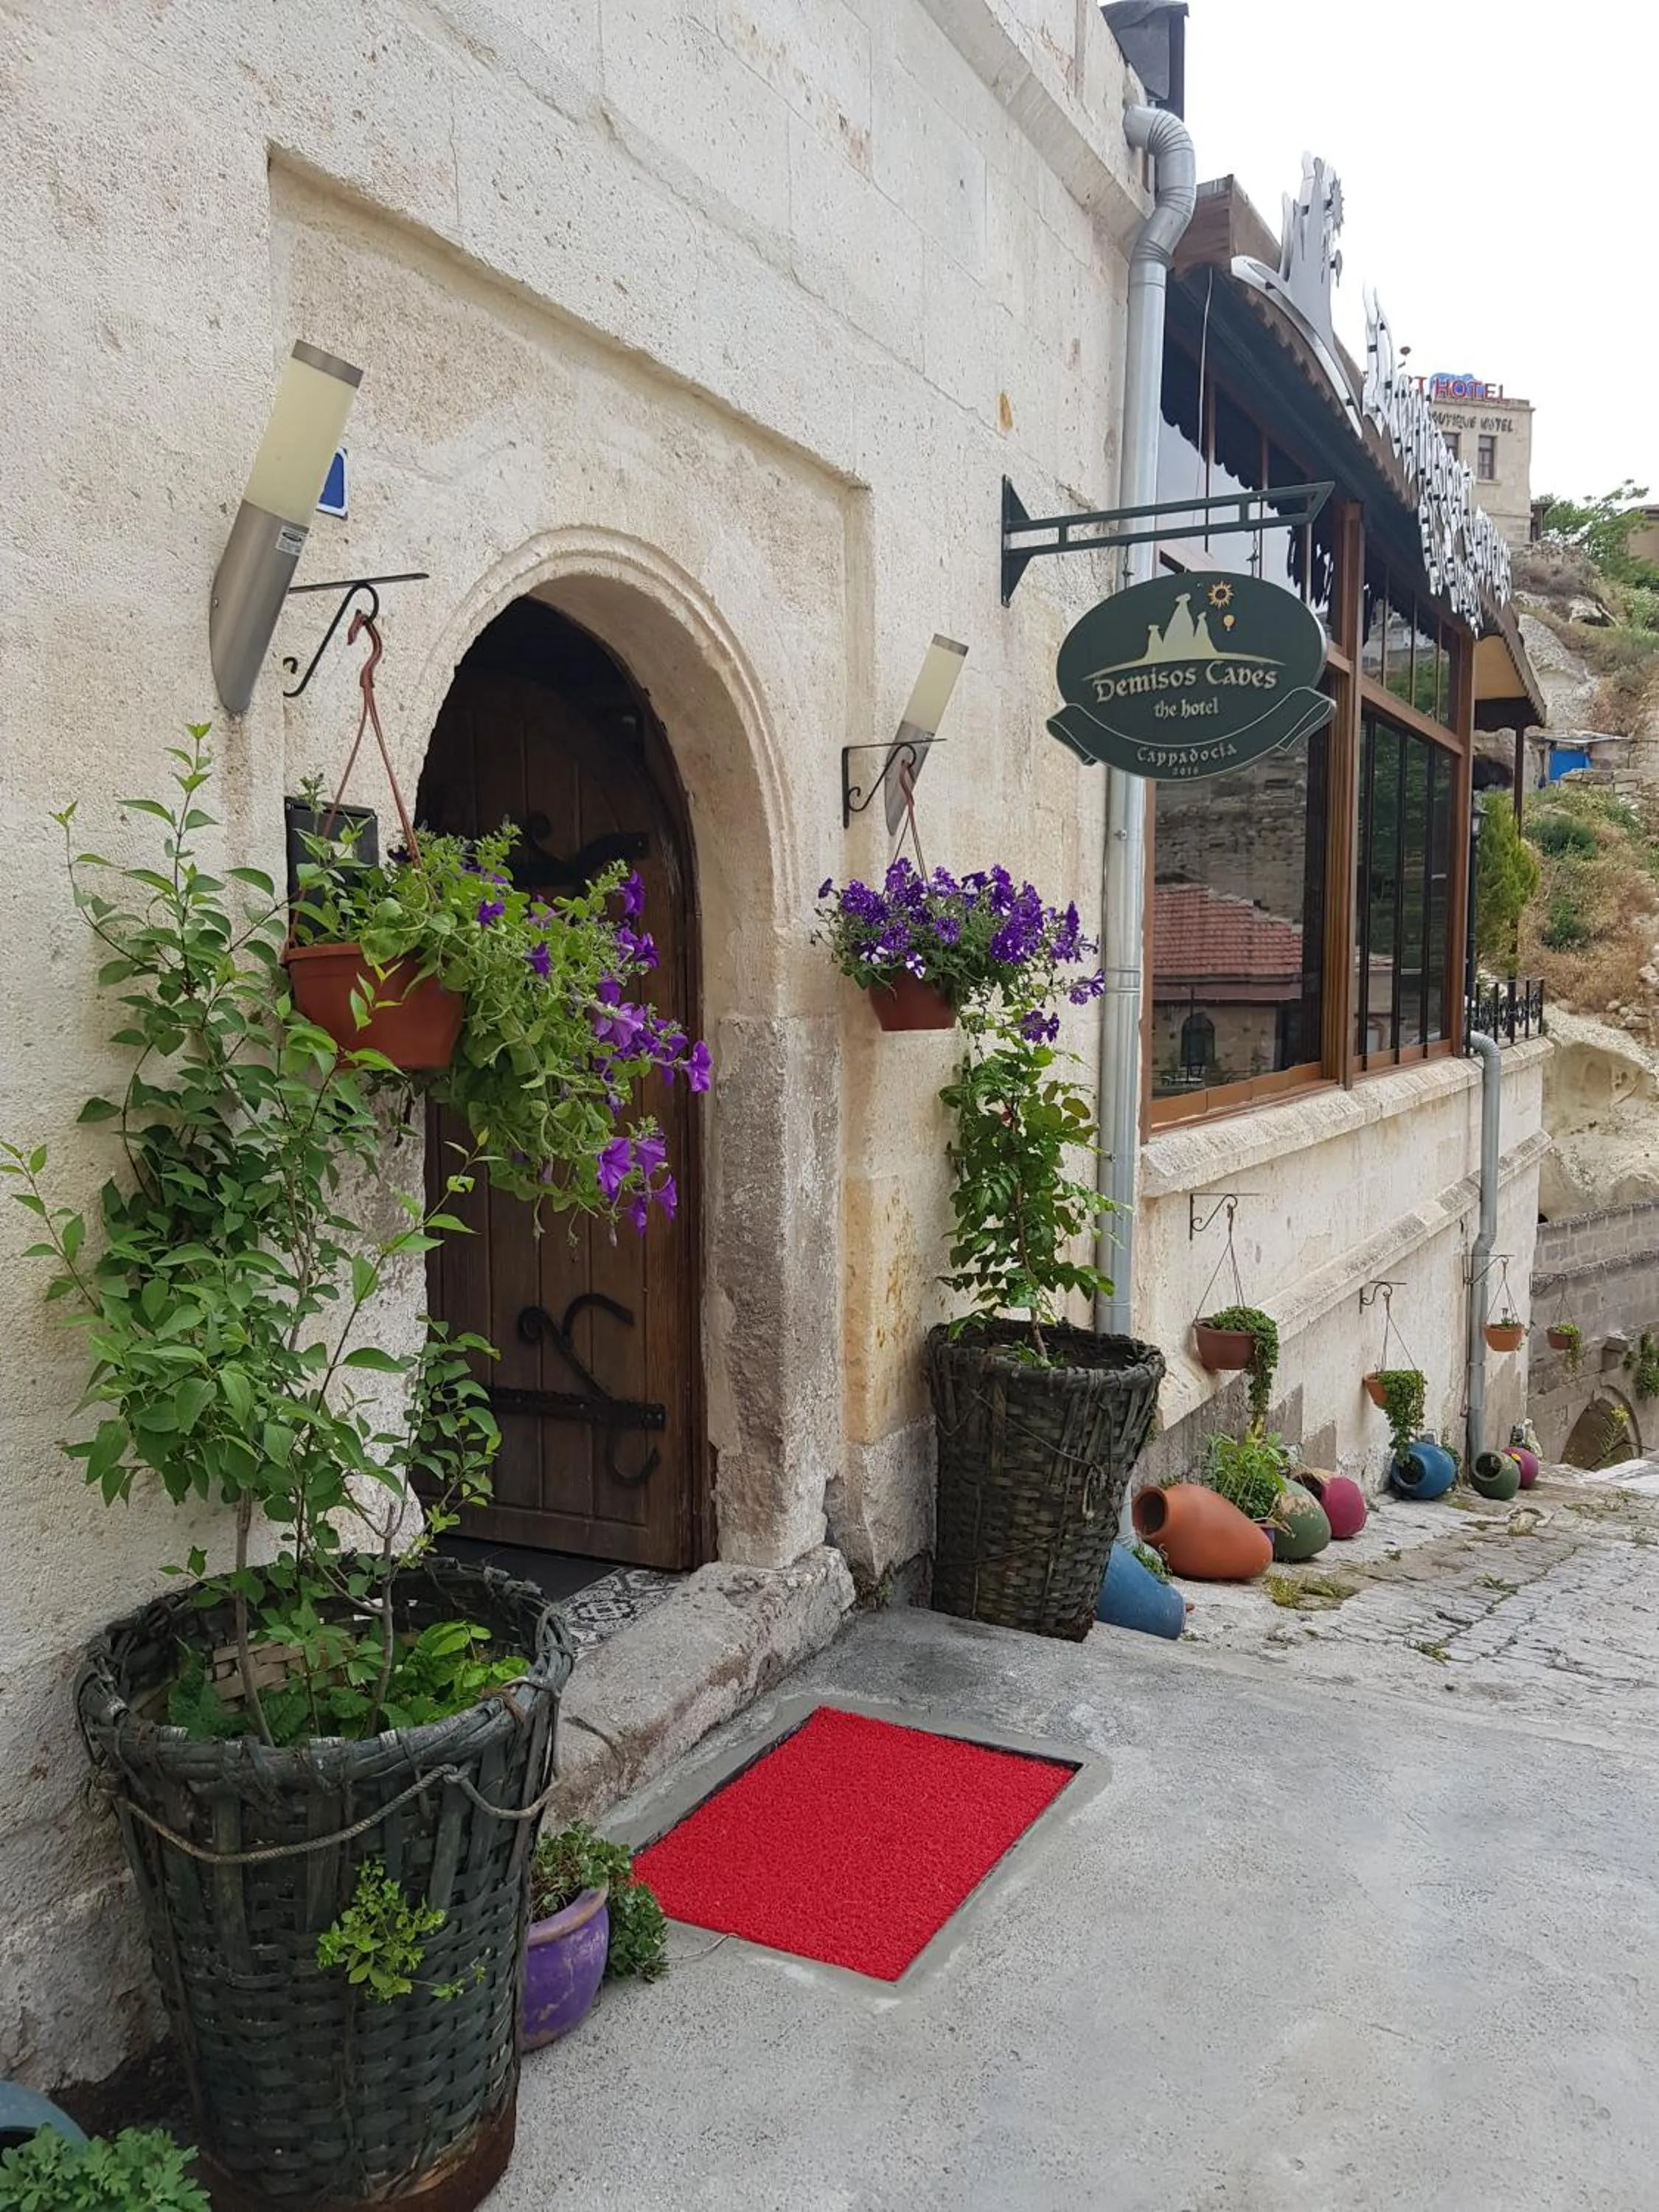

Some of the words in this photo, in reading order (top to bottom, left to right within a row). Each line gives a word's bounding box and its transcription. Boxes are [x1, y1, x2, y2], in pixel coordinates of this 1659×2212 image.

[1436, 377, 1508, 403] HOTEL
[1092, 667, 1196, 703] Demisos
[1206, 660, 1277, 689] Caves
[1155, 700, 1178, 720] the
[1181, 697, 1220, 720] hotel
[1137, 742, 1237, 767] Cappadocia
